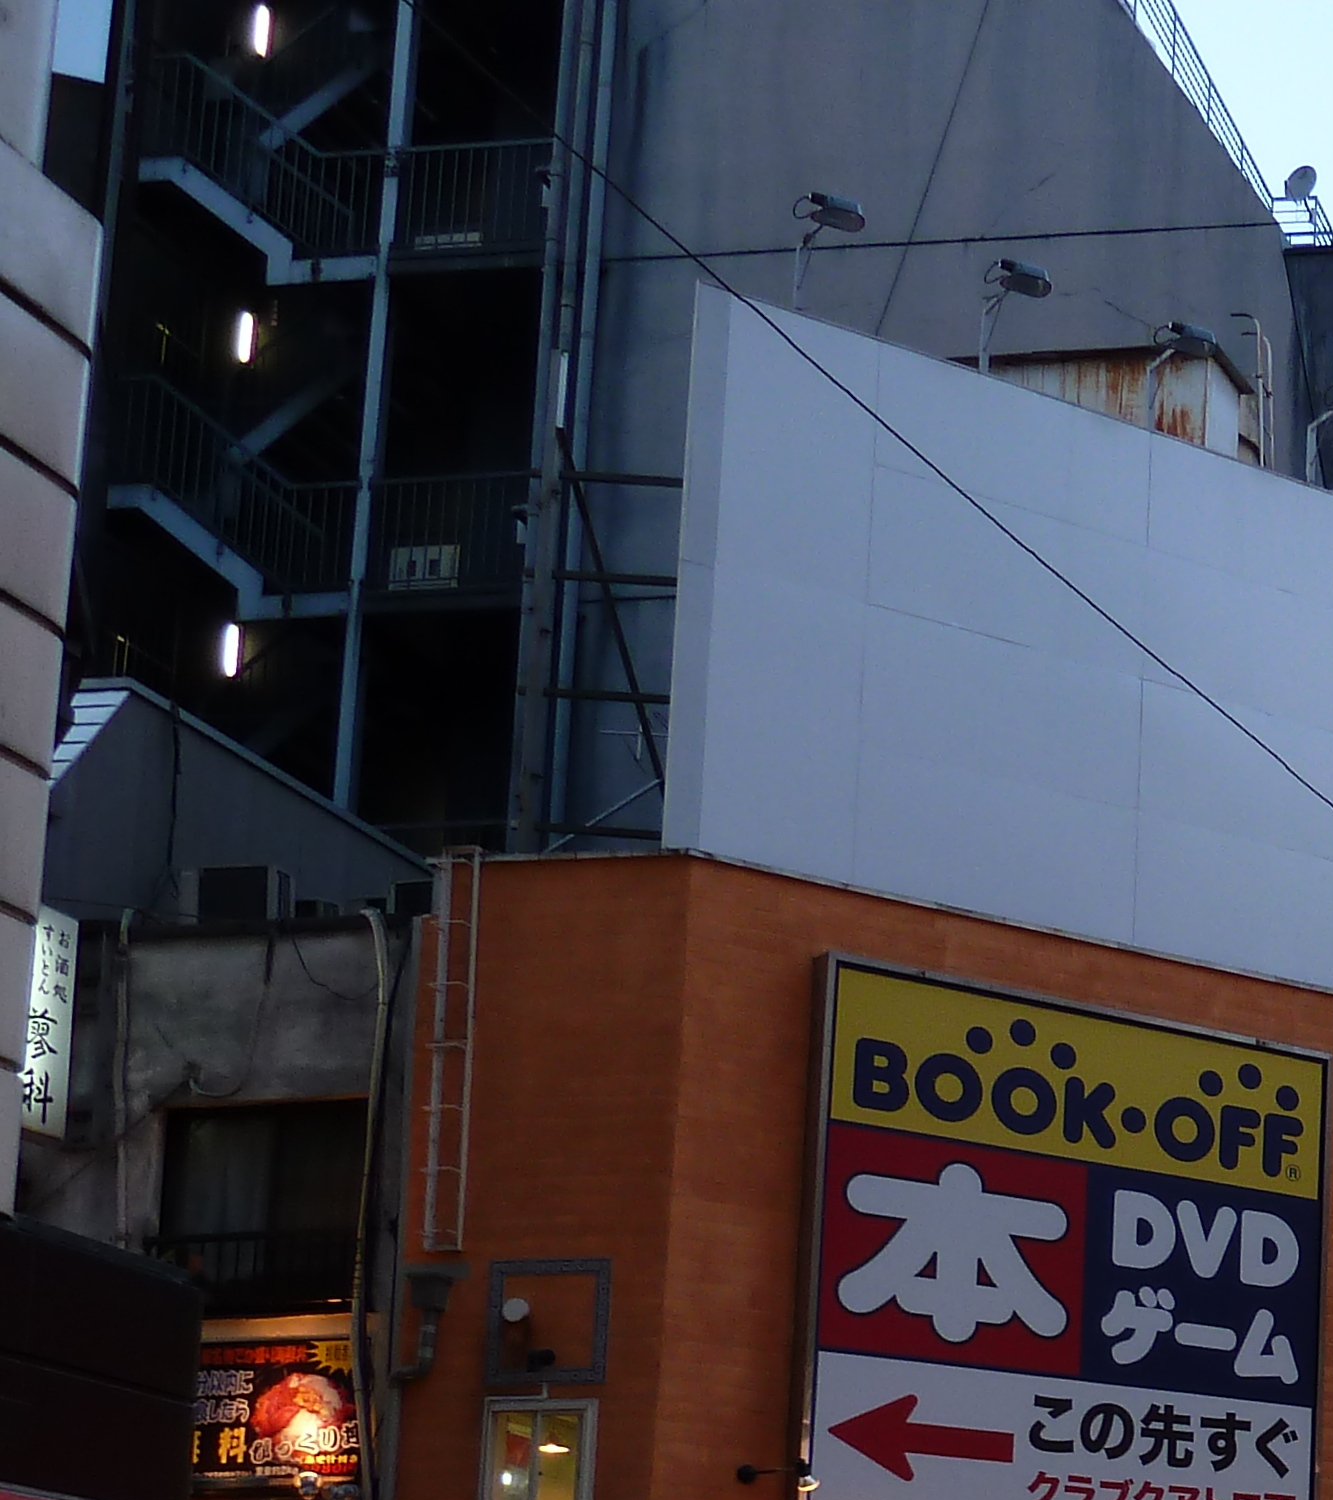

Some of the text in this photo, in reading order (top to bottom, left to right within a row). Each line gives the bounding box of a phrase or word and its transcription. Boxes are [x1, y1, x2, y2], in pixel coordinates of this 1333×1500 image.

[836, 1161, 1069, 1344] 本
[1110, 1188, 1301, 1289] DVD
[1100, 1284, 1300, 1386] ゲーム
[1028, 1394, 1299, 1478] この先すぐ
